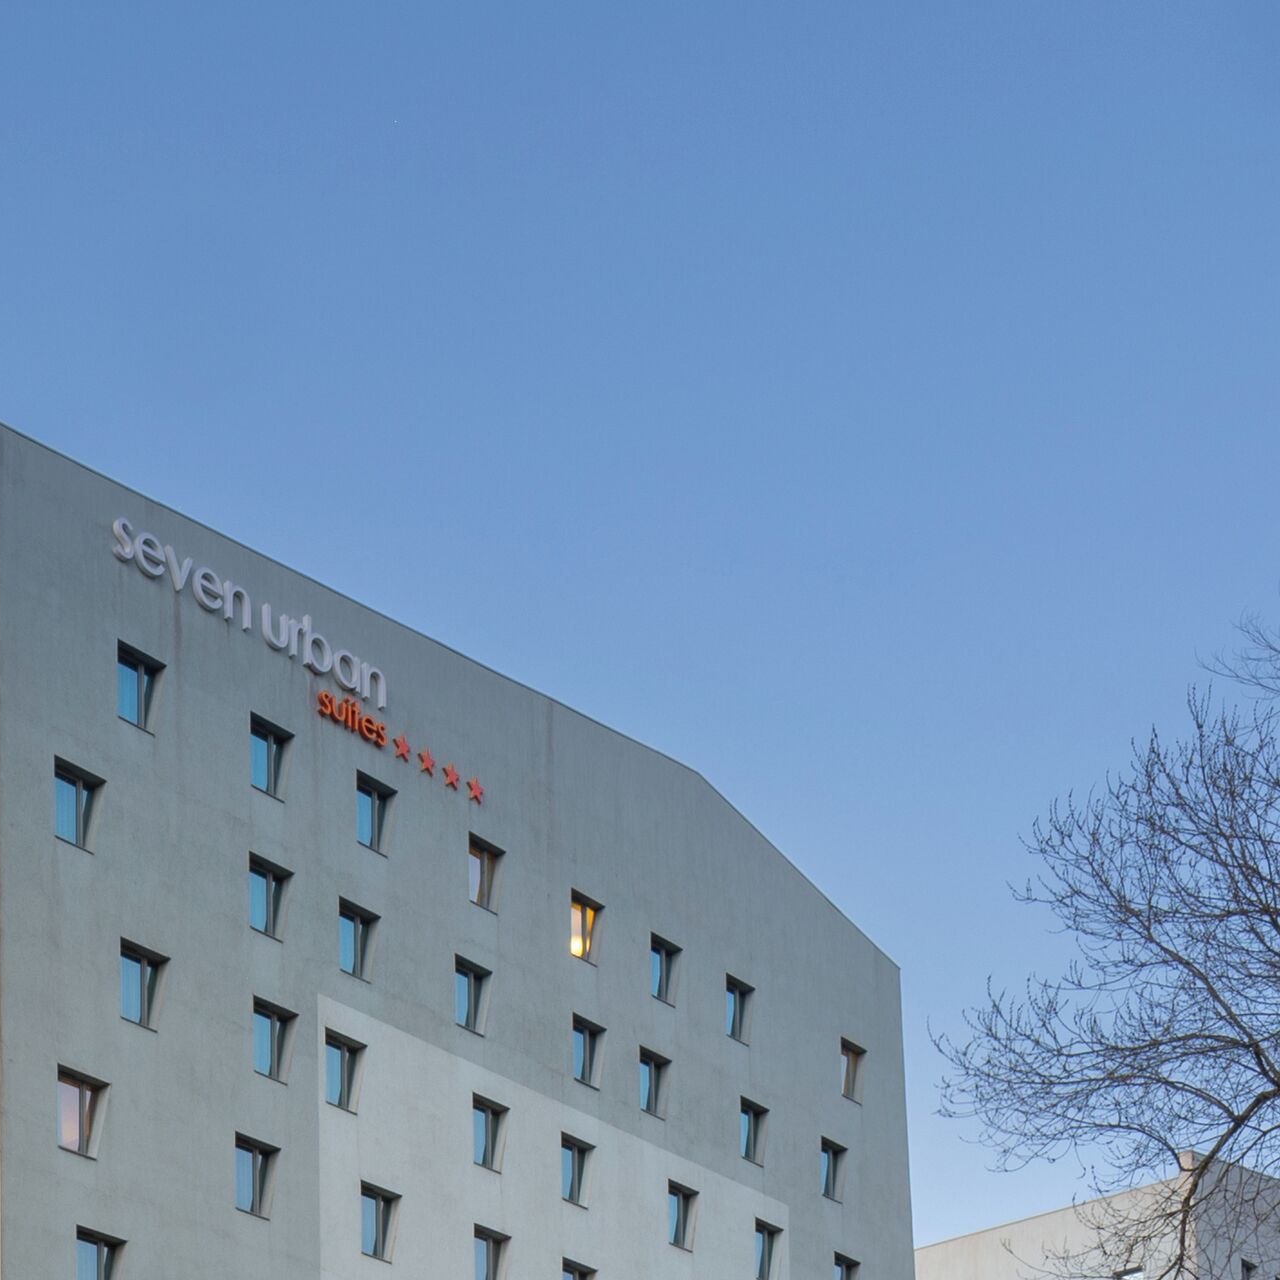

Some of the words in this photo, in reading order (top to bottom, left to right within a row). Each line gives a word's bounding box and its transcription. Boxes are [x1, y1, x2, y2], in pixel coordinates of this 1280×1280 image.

[111, 516, 252, 632] seven
[261, 602, 388, 710] urban
[316, 688, 388, 748] suites
